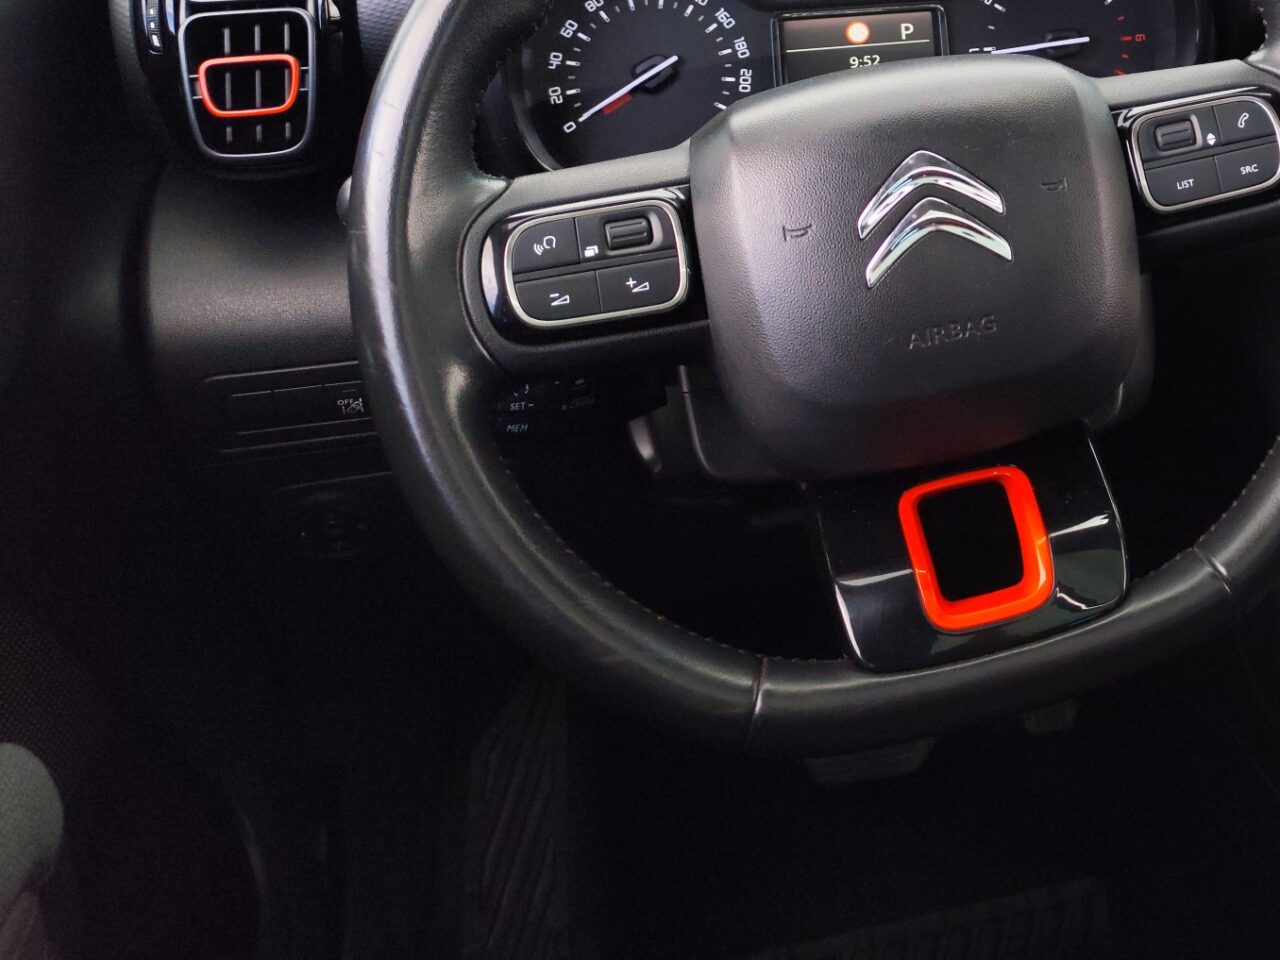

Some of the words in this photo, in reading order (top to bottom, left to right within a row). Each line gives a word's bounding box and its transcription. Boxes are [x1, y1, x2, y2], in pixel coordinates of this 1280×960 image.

[714, 8, 736, 29] 160
[560, 19, 579, 38] 60
[900, 23, 914, 40] P
[1135, 33, 1146, 42] 6
[733, 36, 750, 59] 180
[548, 52, 563, 69] 40
[849, 54, 880, 69] 9:52
[739, 69, 752, 92] 200
[549, 86, 563, 104] 20
[563, 121, 576, 133] 0
[1240, 164, 1259, 175] SRC
[1176, 178, 1194, 190] LIST
[909, 315, 997, 350] AIRBAG
[337, 398, 354, 406] OFF
[506, 423, 528, 433] MEM
